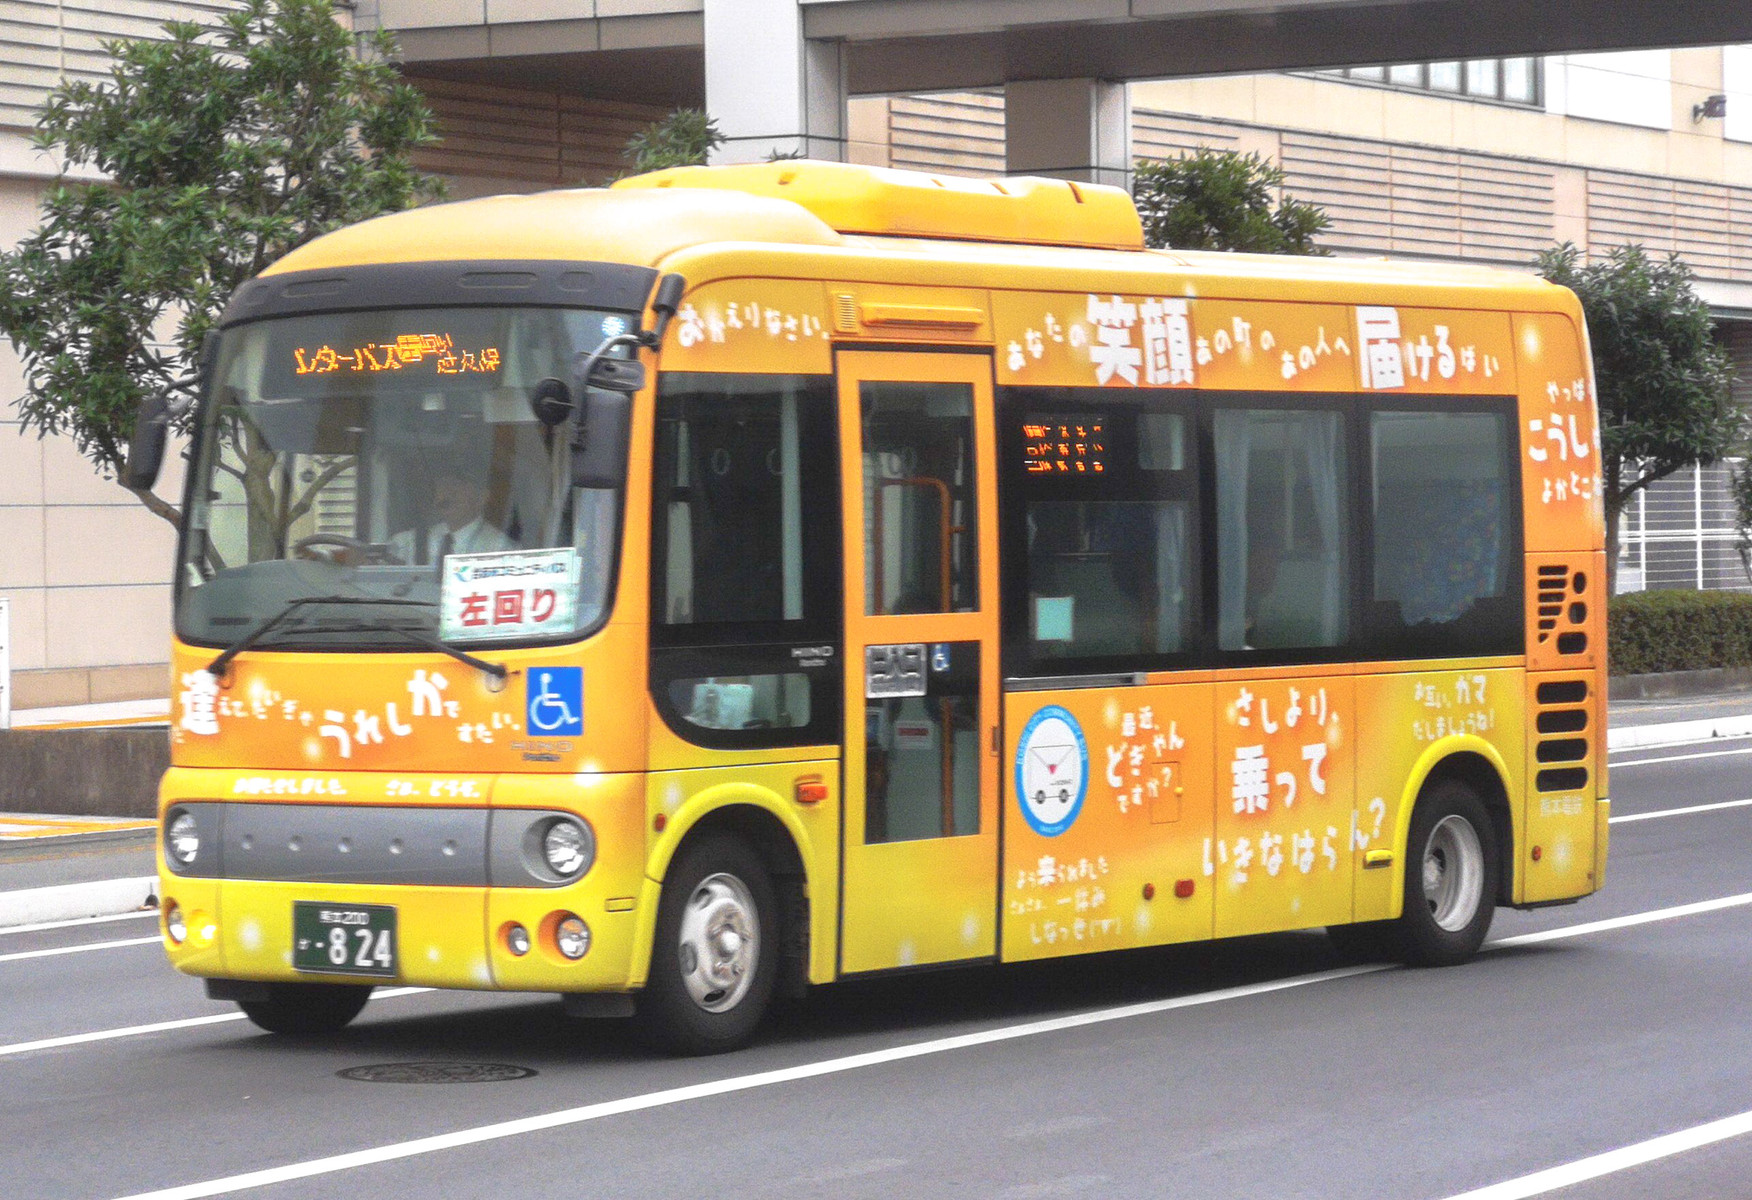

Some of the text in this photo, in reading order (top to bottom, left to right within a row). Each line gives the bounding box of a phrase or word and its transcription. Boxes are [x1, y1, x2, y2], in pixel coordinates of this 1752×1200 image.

[460, 588, 557, 627] 左回り
[791, 646, 834, 658] HINO
[1231, 743, 1328, 815] 乗って
